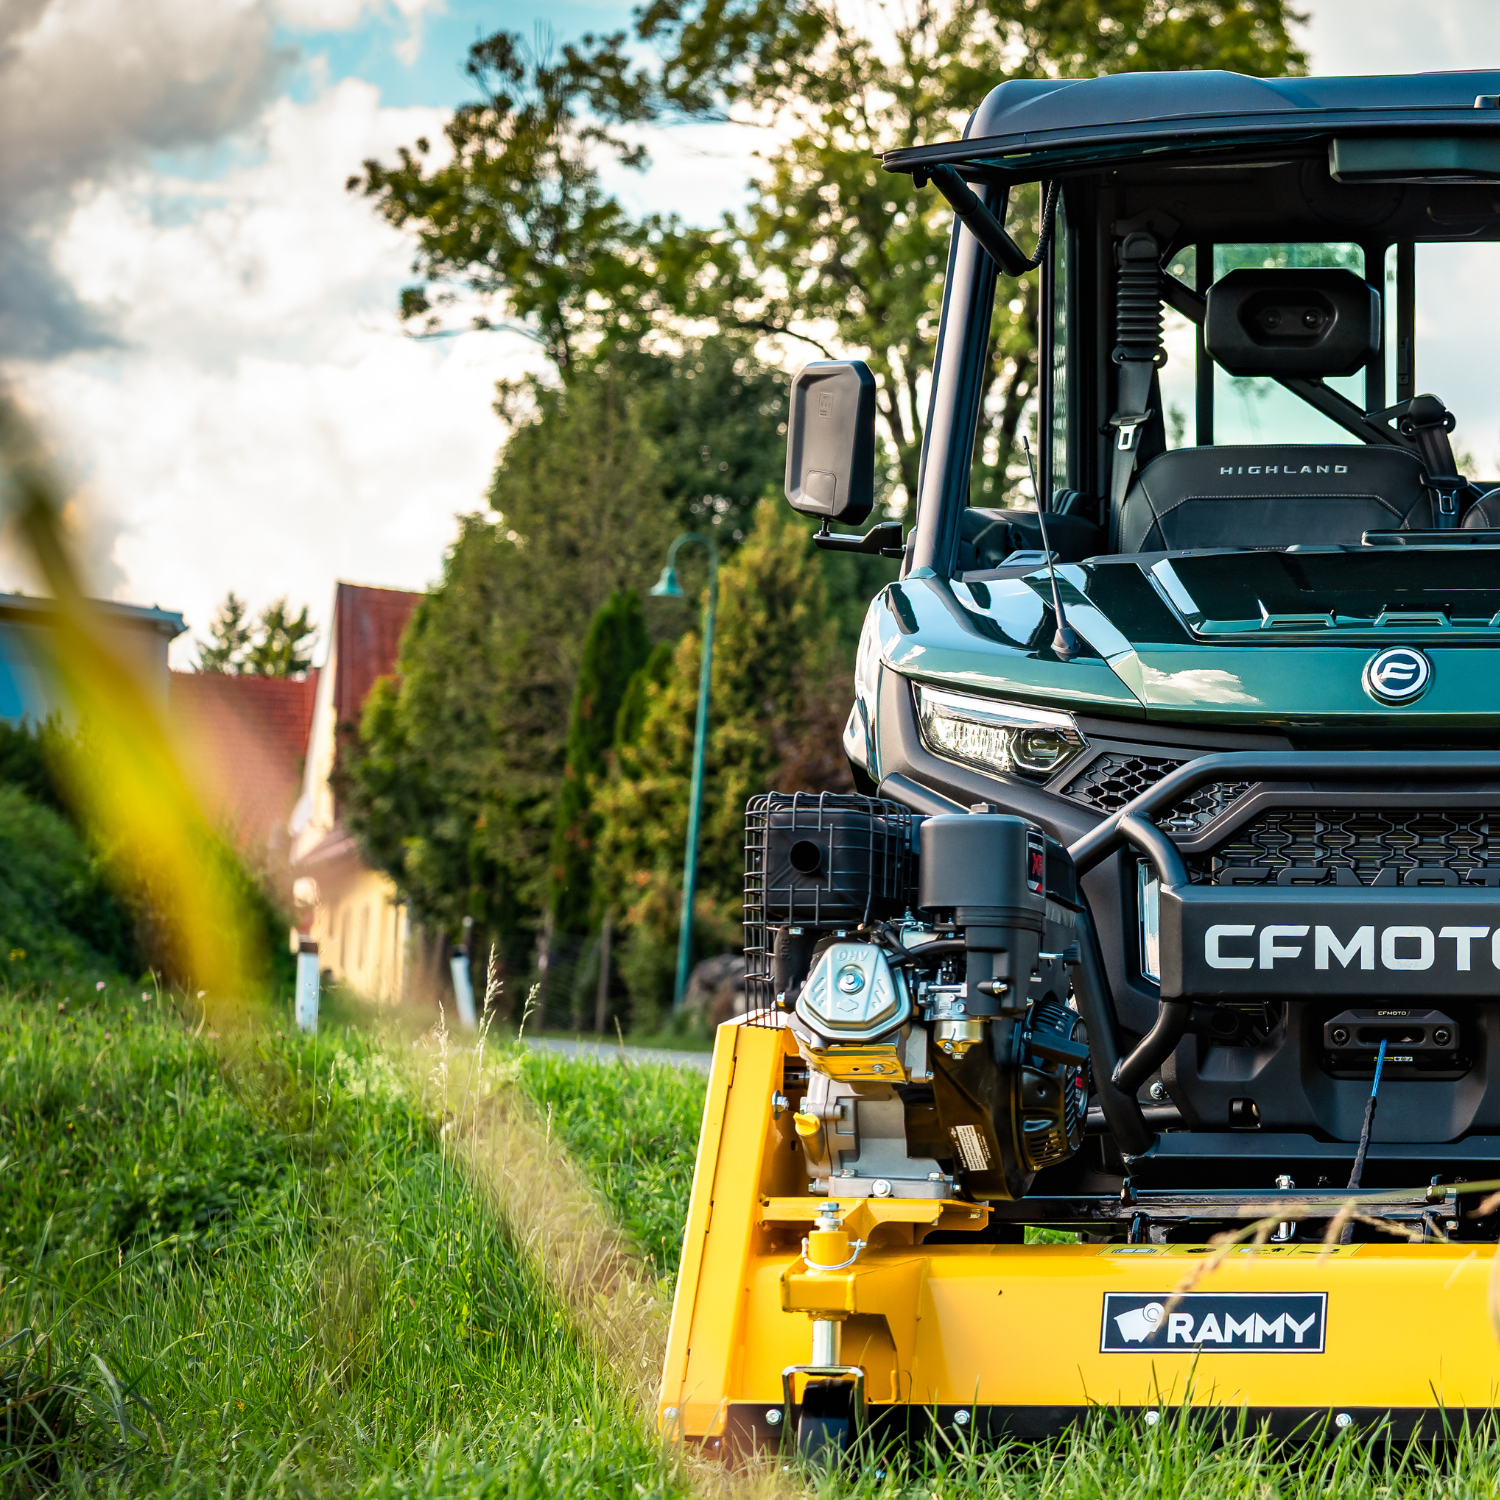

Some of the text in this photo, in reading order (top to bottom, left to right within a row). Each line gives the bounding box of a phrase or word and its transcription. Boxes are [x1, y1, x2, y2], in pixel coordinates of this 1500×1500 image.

[1220, 465, 1348, 475] HIGHLAND
[838, 950, 869, 961] OHV
[1167, 1312, 1316, 1343] RAMMY
